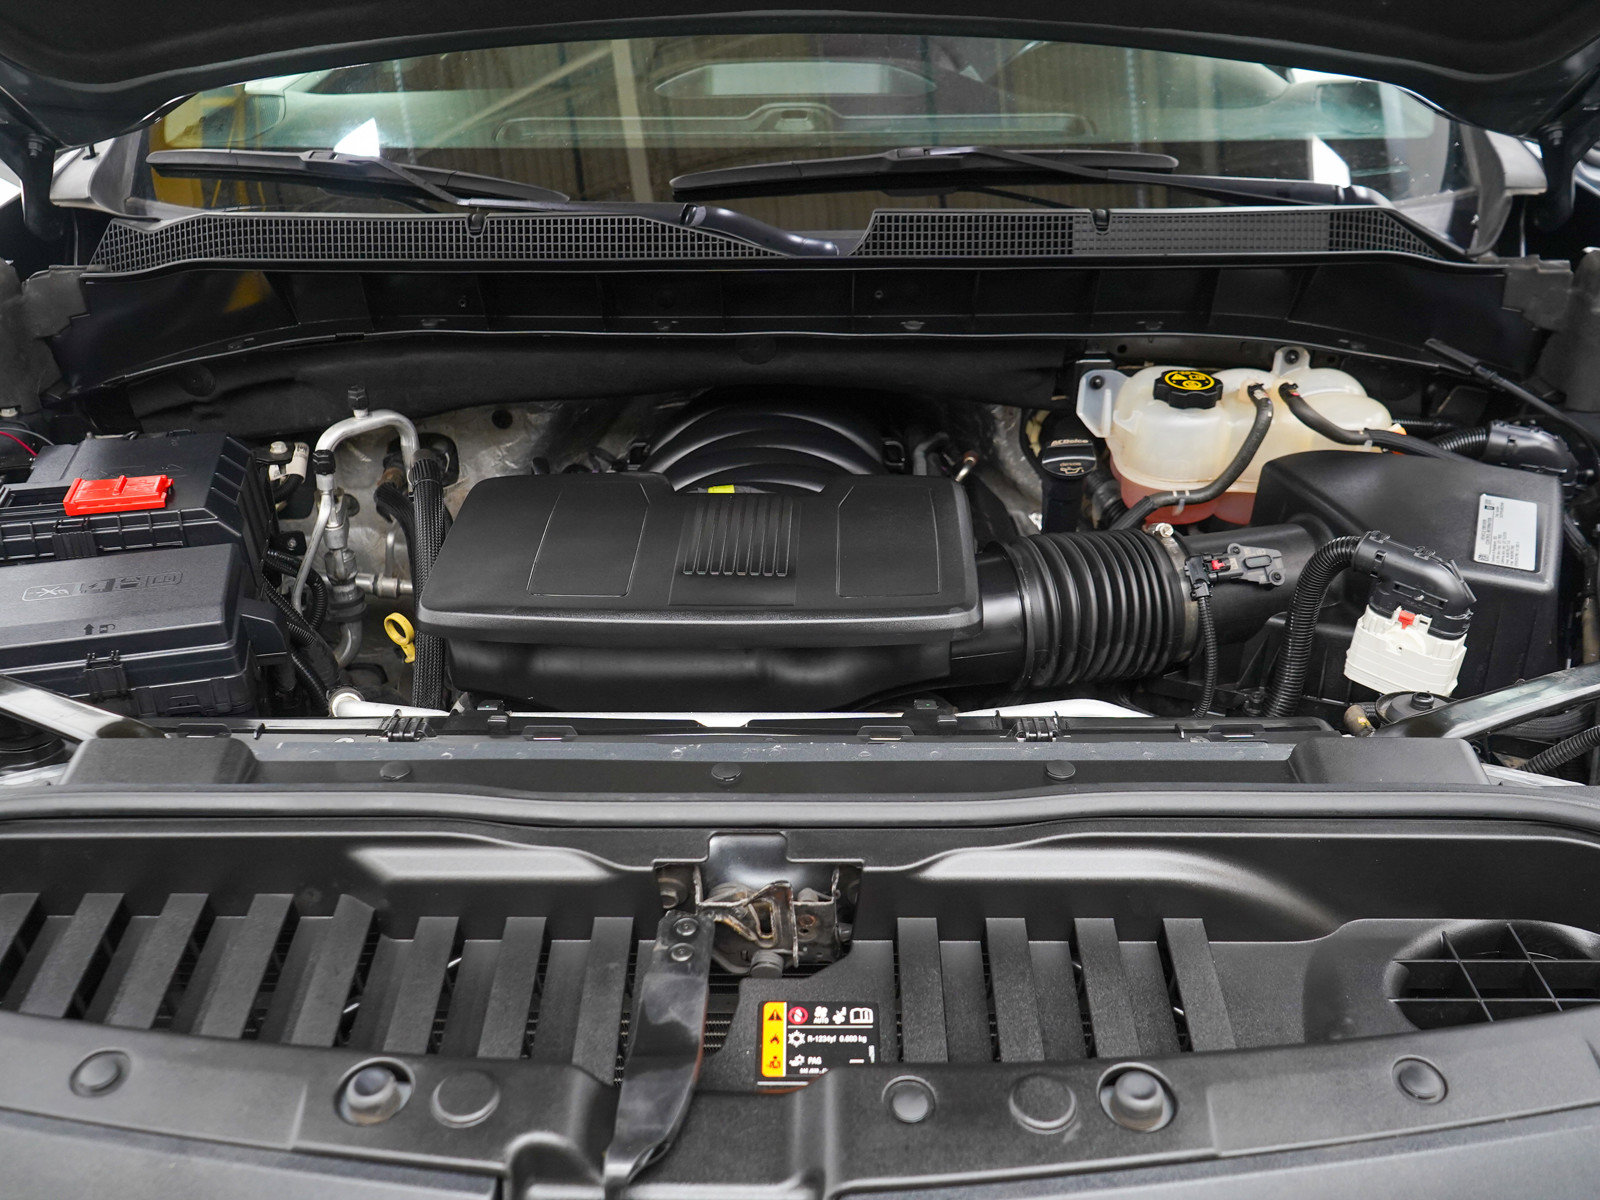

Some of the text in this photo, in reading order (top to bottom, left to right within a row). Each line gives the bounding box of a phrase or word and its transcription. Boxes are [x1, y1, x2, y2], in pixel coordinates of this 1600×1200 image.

[1050, 438, 1088, 447] ACDelco
[807, 1034, 837, 1044] R-1234yf
[858, 1034, 867, 1044] kg
